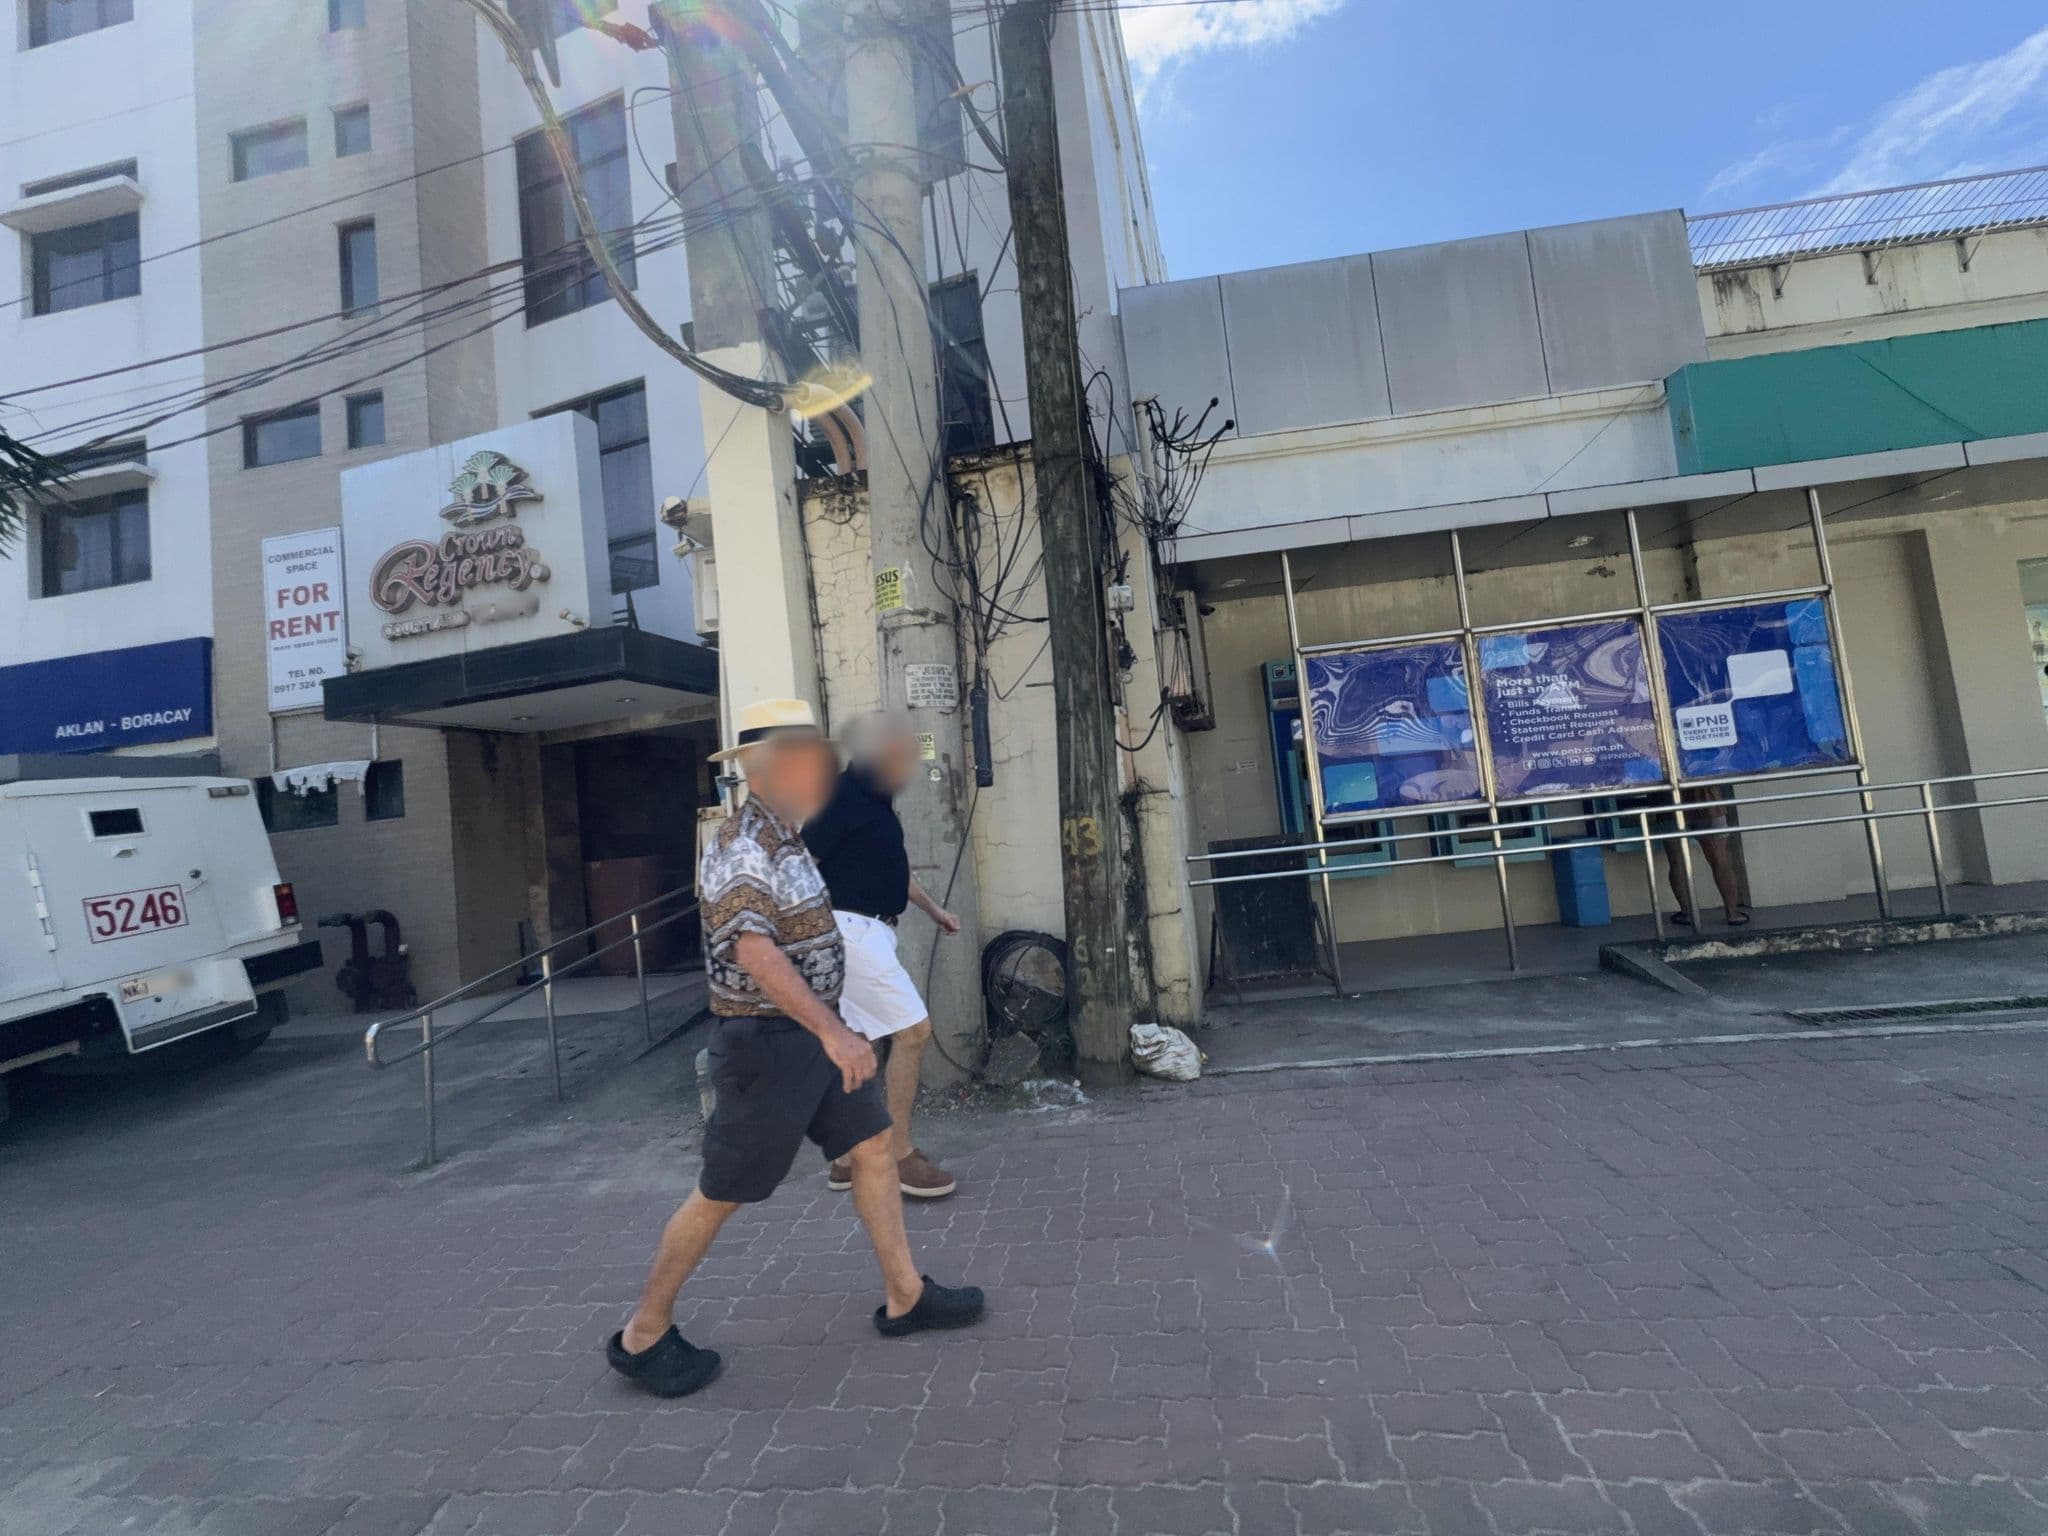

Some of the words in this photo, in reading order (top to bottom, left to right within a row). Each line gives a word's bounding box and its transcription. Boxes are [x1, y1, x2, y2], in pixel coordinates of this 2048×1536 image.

[439, 524, 520, 562] Crown
[268, 546, 335, 563] COMMERCIAL
[286, 561, 319, 574] SPACE
[369, 538, 534, 613] Regency
[277, 582, 330, 609] FOR
[270, 611, 340, 640] RENT
[288, 669, 306, 679] TEL
[309, 666, 326, 675] NO.
[1496, 678, 1533, 688] More
[1535, 673, 1568, 683] than
[274, 683, 296, 694] 0917
[1496, 685, 1525, 698] just
[1527, 685, 1545, 694] an
[1550, 680, 1581, 692] ATM
[1507, 697, 1530, 708] Bills
[1508, 707, 1541, 717] Funds
[1544, 703, 1589, 713] Transfer
[55, 720, 104, 739] AKLAN
[121, 708, 192, 730] BORACAY
[1510, 713, 1570, 726] Checkbook
[1573, 708, 1619, 720] Request
[1696, 714, 1729, 727] PNB
[1511, 723, 1566, 735] Statement
[1569, 718, 1616, 730] Request
[1512, 733, 1545, 744] Credit
[1548, 729, 1575, 740] Card
[1577, 726, 1605, 737] Cash
[1608, 723, 1656, 735] Advance
[1682, 728, 1708, 736] EVERY
[1684, 732, 1730, 742] TOGETHER
[1532, 742, 1624, 758] www.pnb.com.ph
[91, 891, 181, 937] 5246
